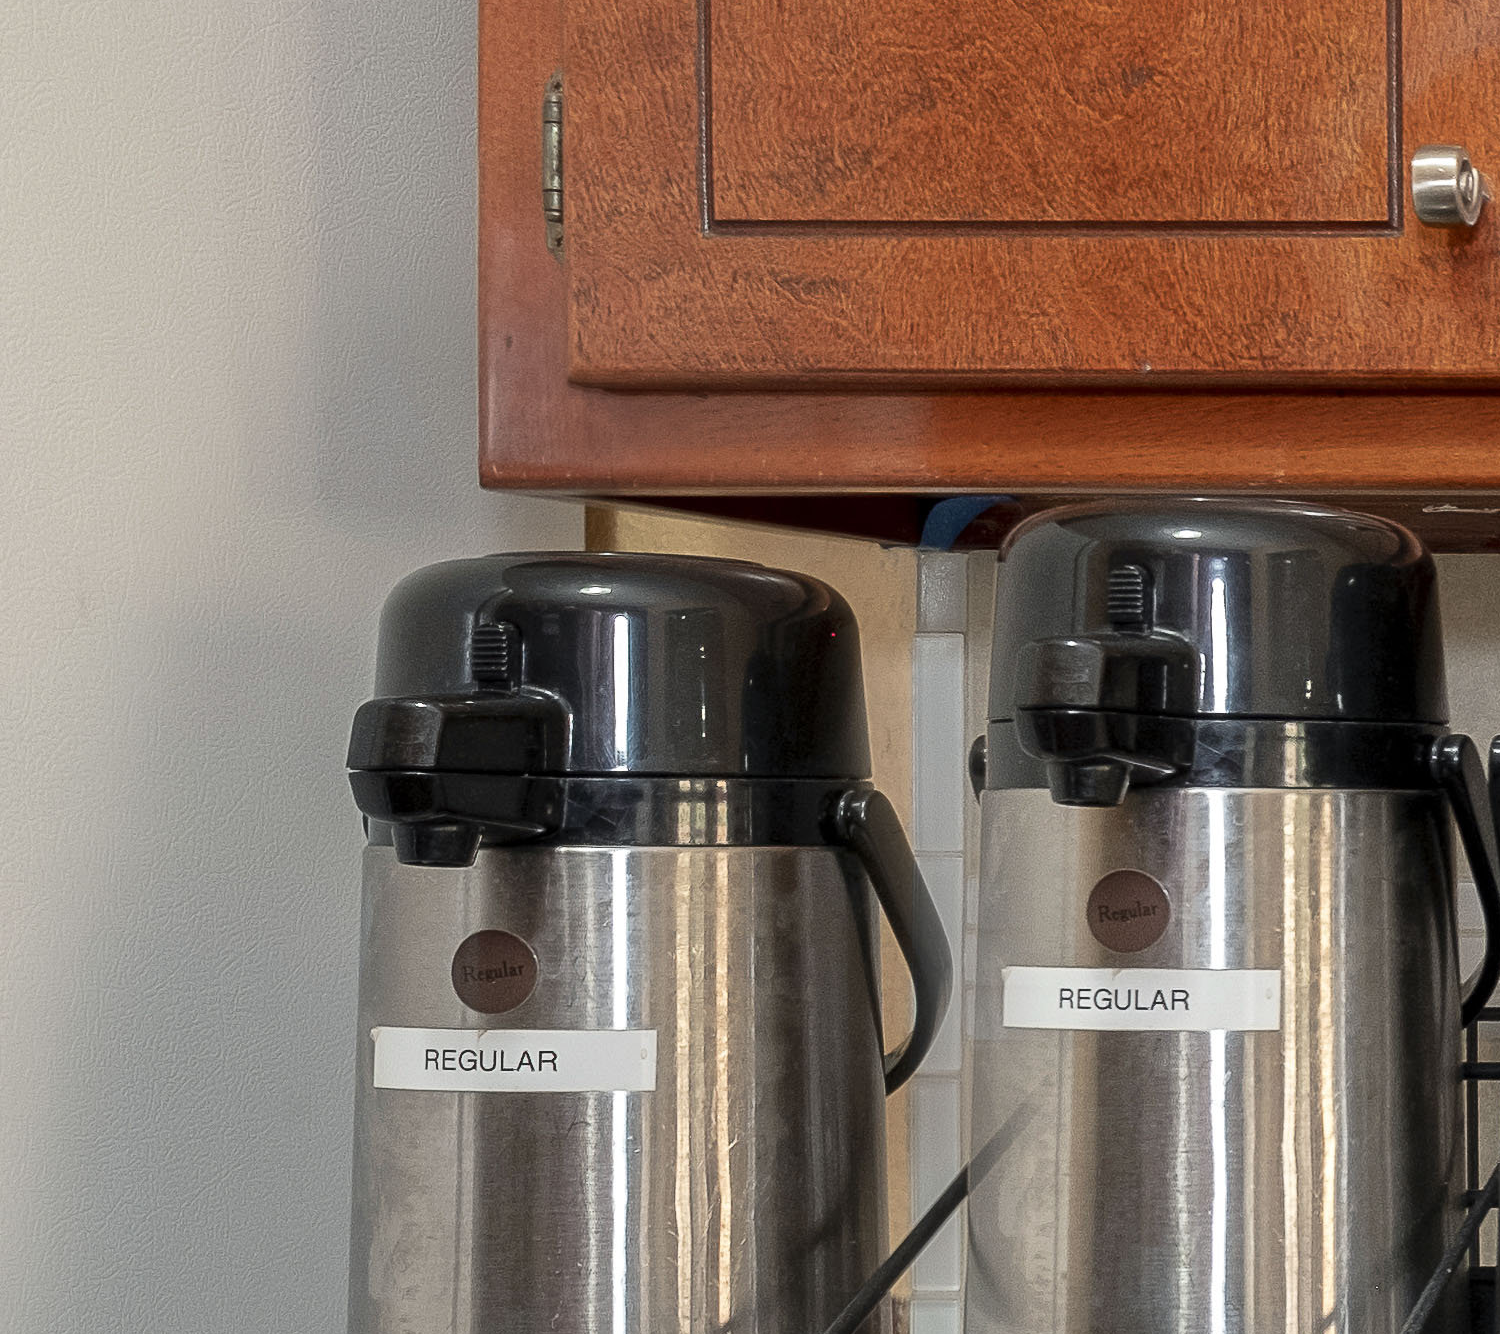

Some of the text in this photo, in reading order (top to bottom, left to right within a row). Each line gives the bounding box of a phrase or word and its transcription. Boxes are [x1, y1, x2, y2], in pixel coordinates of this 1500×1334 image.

[1099, 902, 1157, 923] Regular
[463, 962, 525, 983] Regular
[1059, 988, 1190, 1011] REGULAR
[425, 1048, 558, 1072] REGULAR
